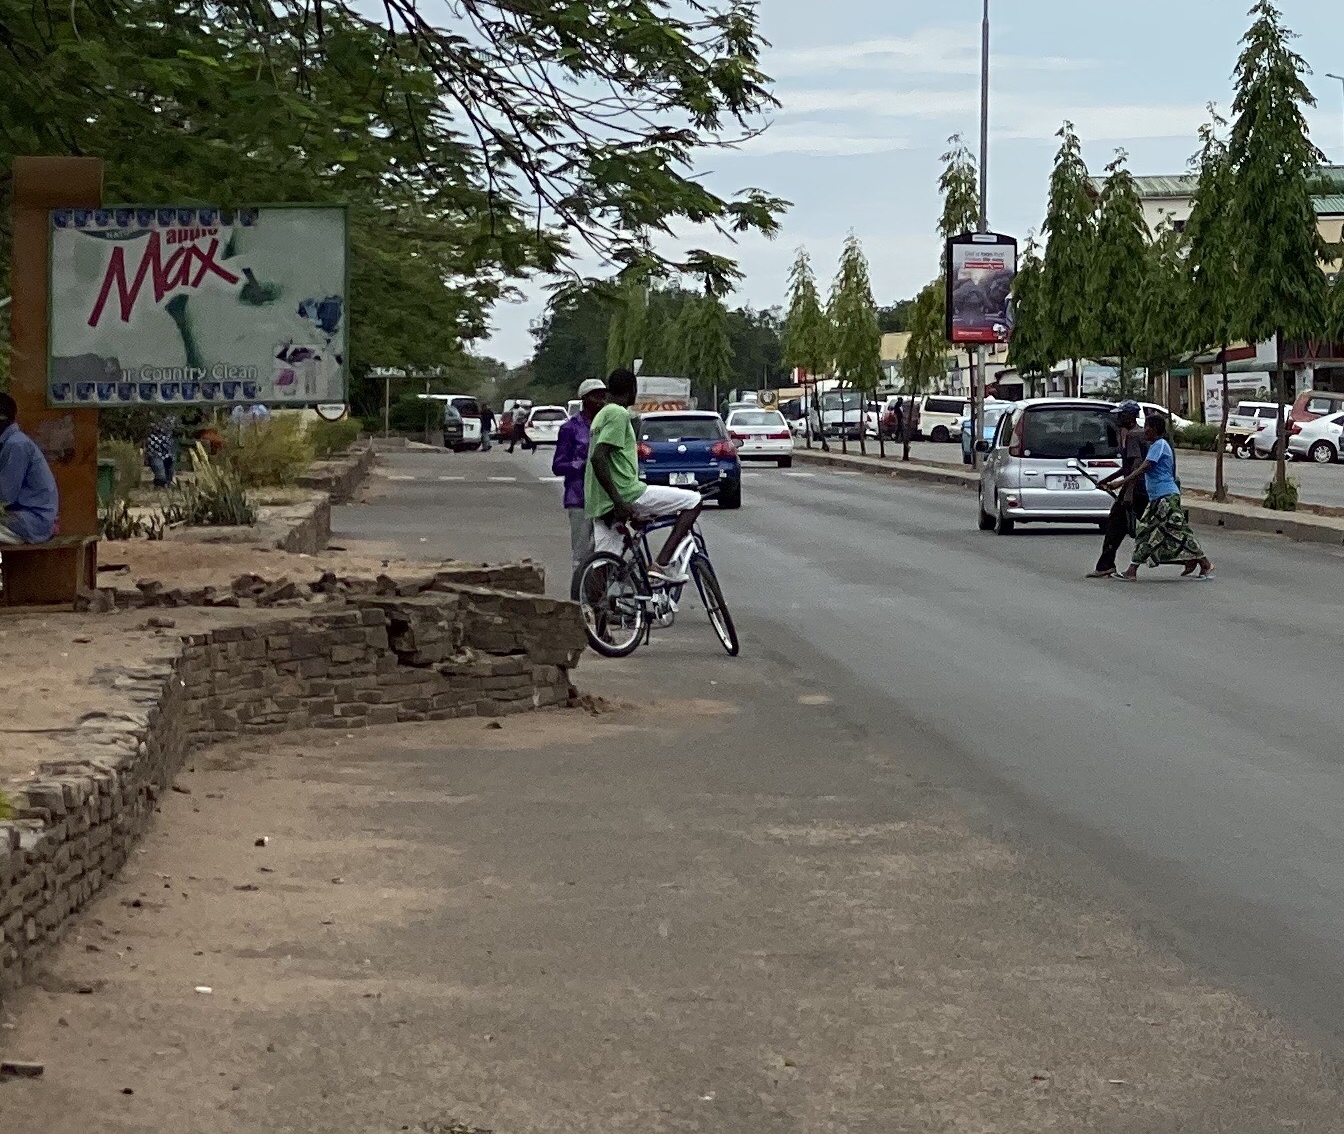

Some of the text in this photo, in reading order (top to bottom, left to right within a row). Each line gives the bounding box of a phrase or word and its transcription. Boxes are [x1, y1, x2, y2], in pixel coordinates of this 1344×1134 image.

[87, 230, 240, 328] Max
[140, 364, 207, 383] Country
[211, 362, 258, 380] Clean
